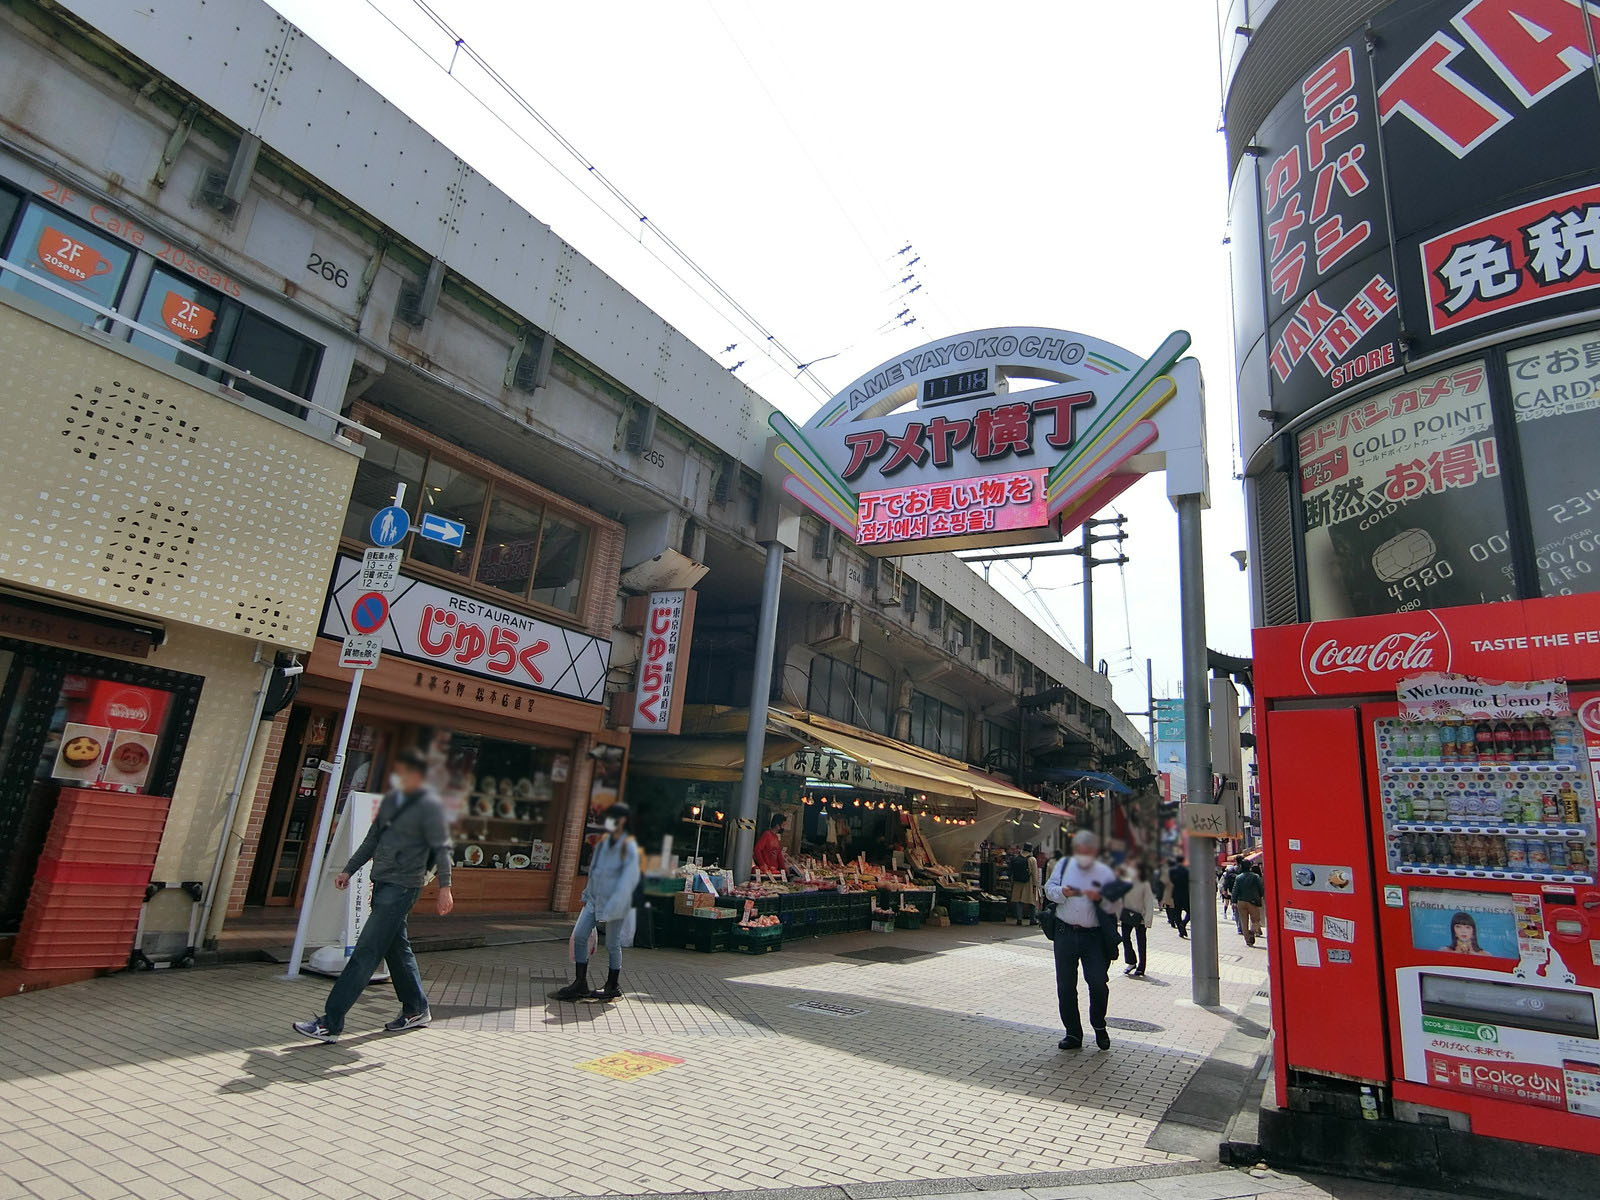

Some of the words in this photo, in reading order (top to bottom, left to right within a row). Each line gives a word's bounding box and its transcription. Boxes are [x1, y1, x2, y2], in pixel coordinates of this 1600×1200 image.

[1302, 46, 1371, 275] ヨドバシ
[40, 177, 75, 206] 2F
[88, 205, 146, 247] Cafe
[155, 239, 242, 299] 20seats
[1265, 145, 1305, 305] カメラ
[43, 253, 87, 281] 20seats
[57, 237, 84, 263] 2F
[305, 252, 350, 290] 266
[170, 316, 200, 337] Eat-in
[176, 299, 201, 323] 2F
[1307, 273, 1398, 378] FREE
[1269, 287, 1338, 384] TAX
[849, 335, 1085, 411] AMEYAYOKOCHO
[1331, 342, 1395, 389] STORE
[1299, 366, 1485, 459] ヨドバシカメラ
[1352, 427, 1407, 459] GOLD
[1413, 402, 1488, 438] POINT
[841, 390, 1096, 479] アメヤ横丁
[1303, 450, 1344, 480] 他カード
[1313, 470, 1333, 487] より
[1358, 503, 1397, 532] GOLD
[1470, 529, 1510, 562] 00
[848, 568, 861, 585] 264
[1387, 559, 1454, 601] 4980
[449, 596, 536, 632] RESTAURANT
[650, 595, 683, 605] レストラン
[417, 604, 550, 686] じゅらく
[666, 606, 681, 655] 東京名物
[1470, 636, 1529, 653] TASTE
[1530, 633, 1570, 648] THE
[1573, 630, 1600, 645] FE
[637, 606, 672, 724] じゅらく
[1309, 630, 1440, 676] Coca-Cola
[1406, 683, 1484, 700] Welcome
[1472, 698, 1487, 708] to
[1491, 693, 1541, 709] Ueno
[1431, 1038, 1516, 1060] さりげなく、未来です。
[1474, 1065, 1525, 1088] Coke
[1528, 1072, 1561, 1094] ON
